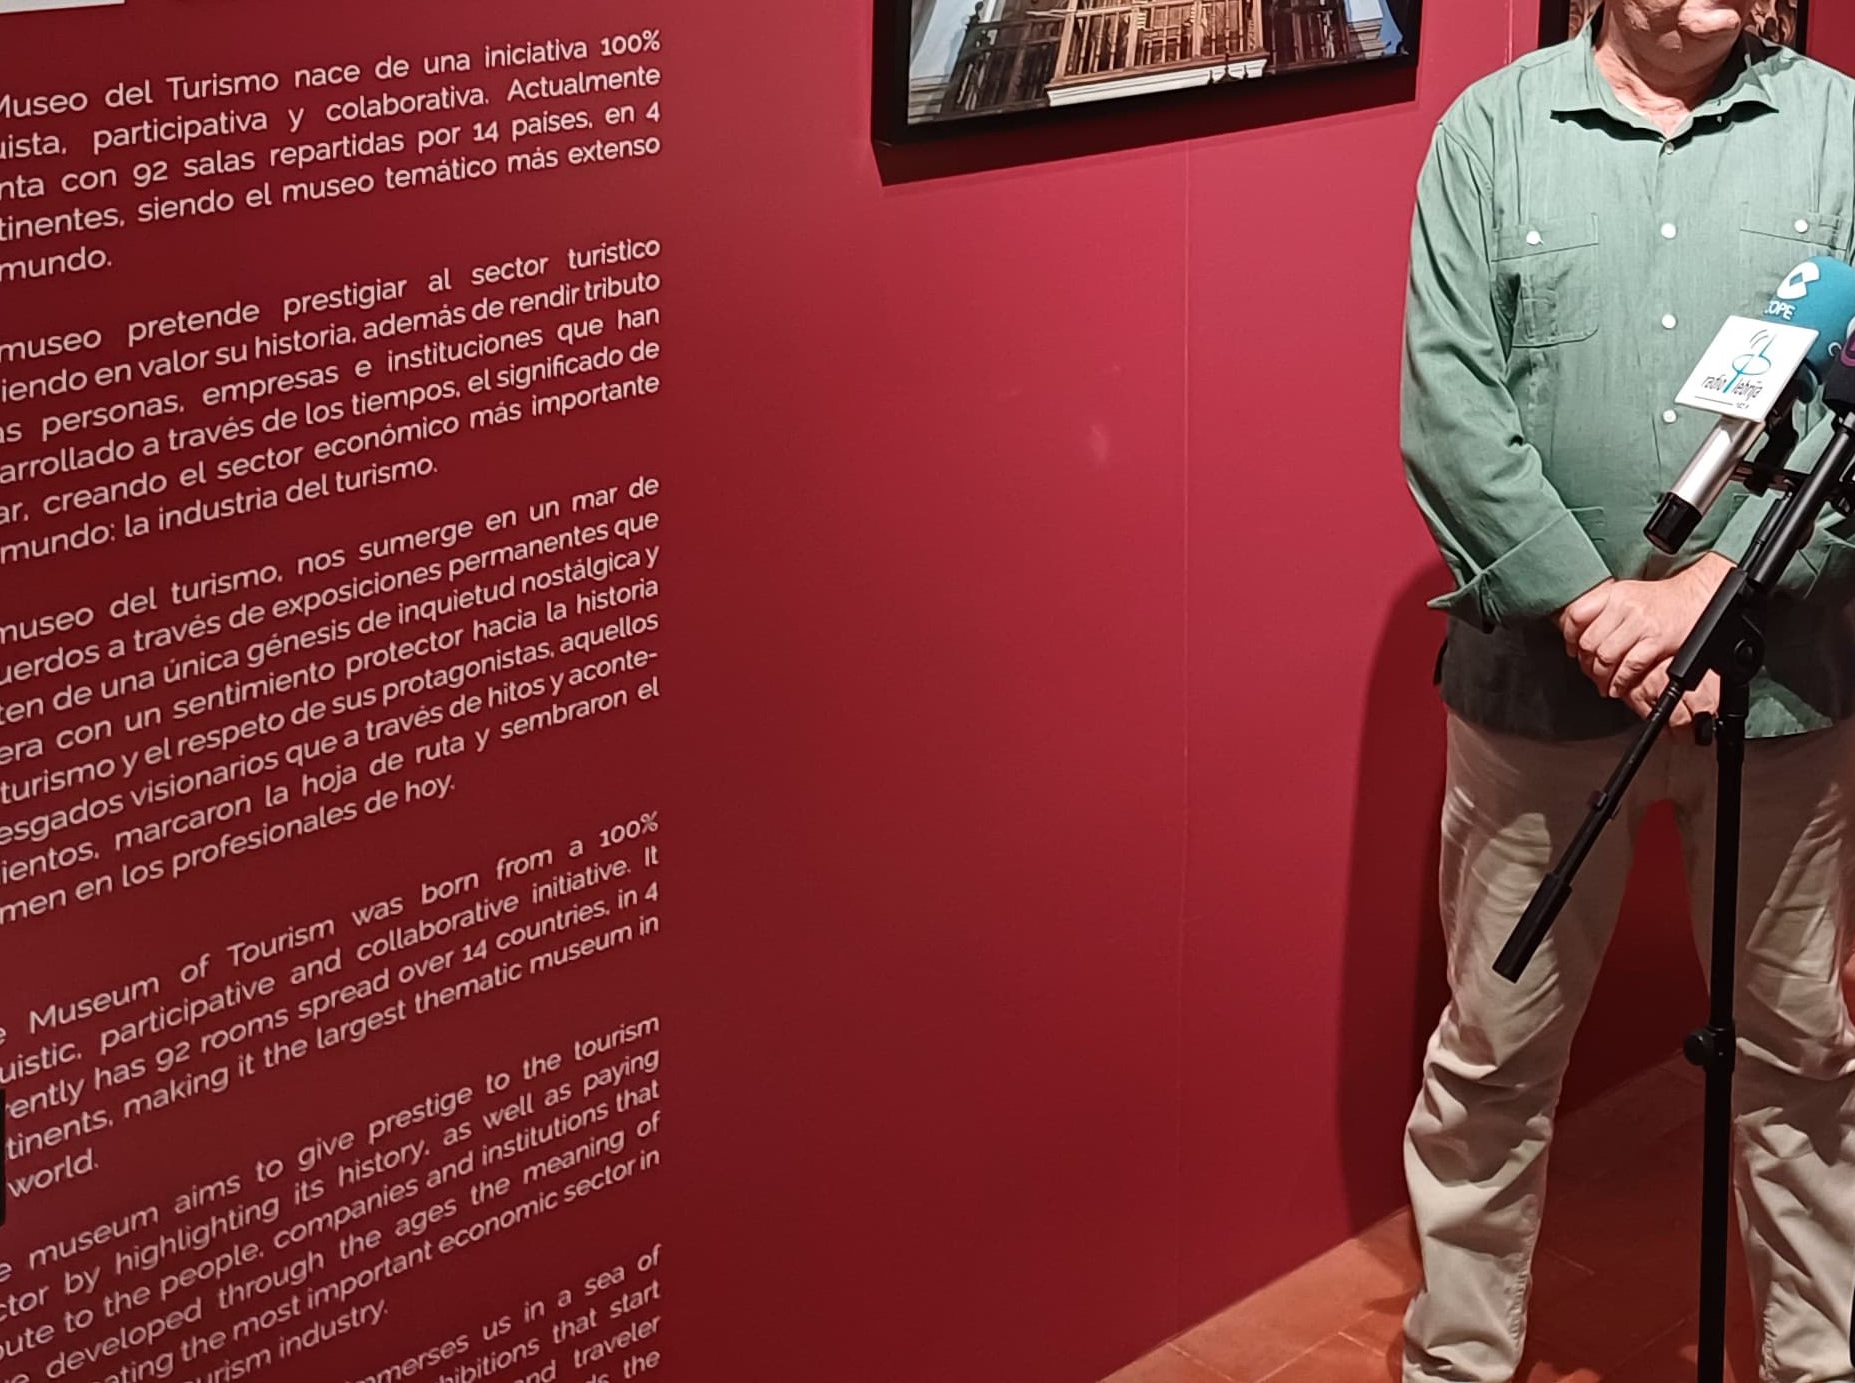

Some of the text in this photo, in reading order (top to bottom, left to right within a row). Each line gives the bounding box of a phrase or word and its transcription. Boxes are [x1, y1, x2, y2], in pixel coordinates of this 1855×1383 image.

[94, 110, 267, 155] participativa
[288, 108, 304, 132] y
[507, 66, 660, 101] Actualmente
[105, 80, 153, 107] del
[166, 73, 279, 101] Turismo
[295, 65, 360, 88] nace
[375, 55, 409, 79] de
[424, 53, 470, 74] una
[485, 38, 587, 68] iniciativa
[601, 29, 660, 56] 100%
[61, 169, 116, 192] con
[133, 161, 168, 187] 92
[184, 150, 255, 177] salas
[270, 132, 404, 169] repartidas
[418, 126, 461, 154] por
[473, 121, 499, 142] 14
[605, 106, 634, 124] en
[646, 101, 660, 122] 4
[138, 137, 660, 222] siendo el museo temático más extenso
[0, 759, 115, 804] turismo
[121, 751, 138, 778] y
[145, 737, 172, 764] el
[178, 713, 285, 756] respeto
[291, 700, 326, 725] de
[332, 688, 377, 714] sus
[560, 613, 658, 653] aquellos
[56, 578, 658, 749] con un sentimiento protector hacia la historia
[30, 811, 658, 1034] Museum of Tourism was born from a 100%
[124, 916, 658, 1118] making it the largest thematic museum in
[29, 1017, 659, 1270] museum aims to give prestige to the tourism
[553, 1280, 660, 1344] that start
[574, 1316, 660, 1368] traveler
